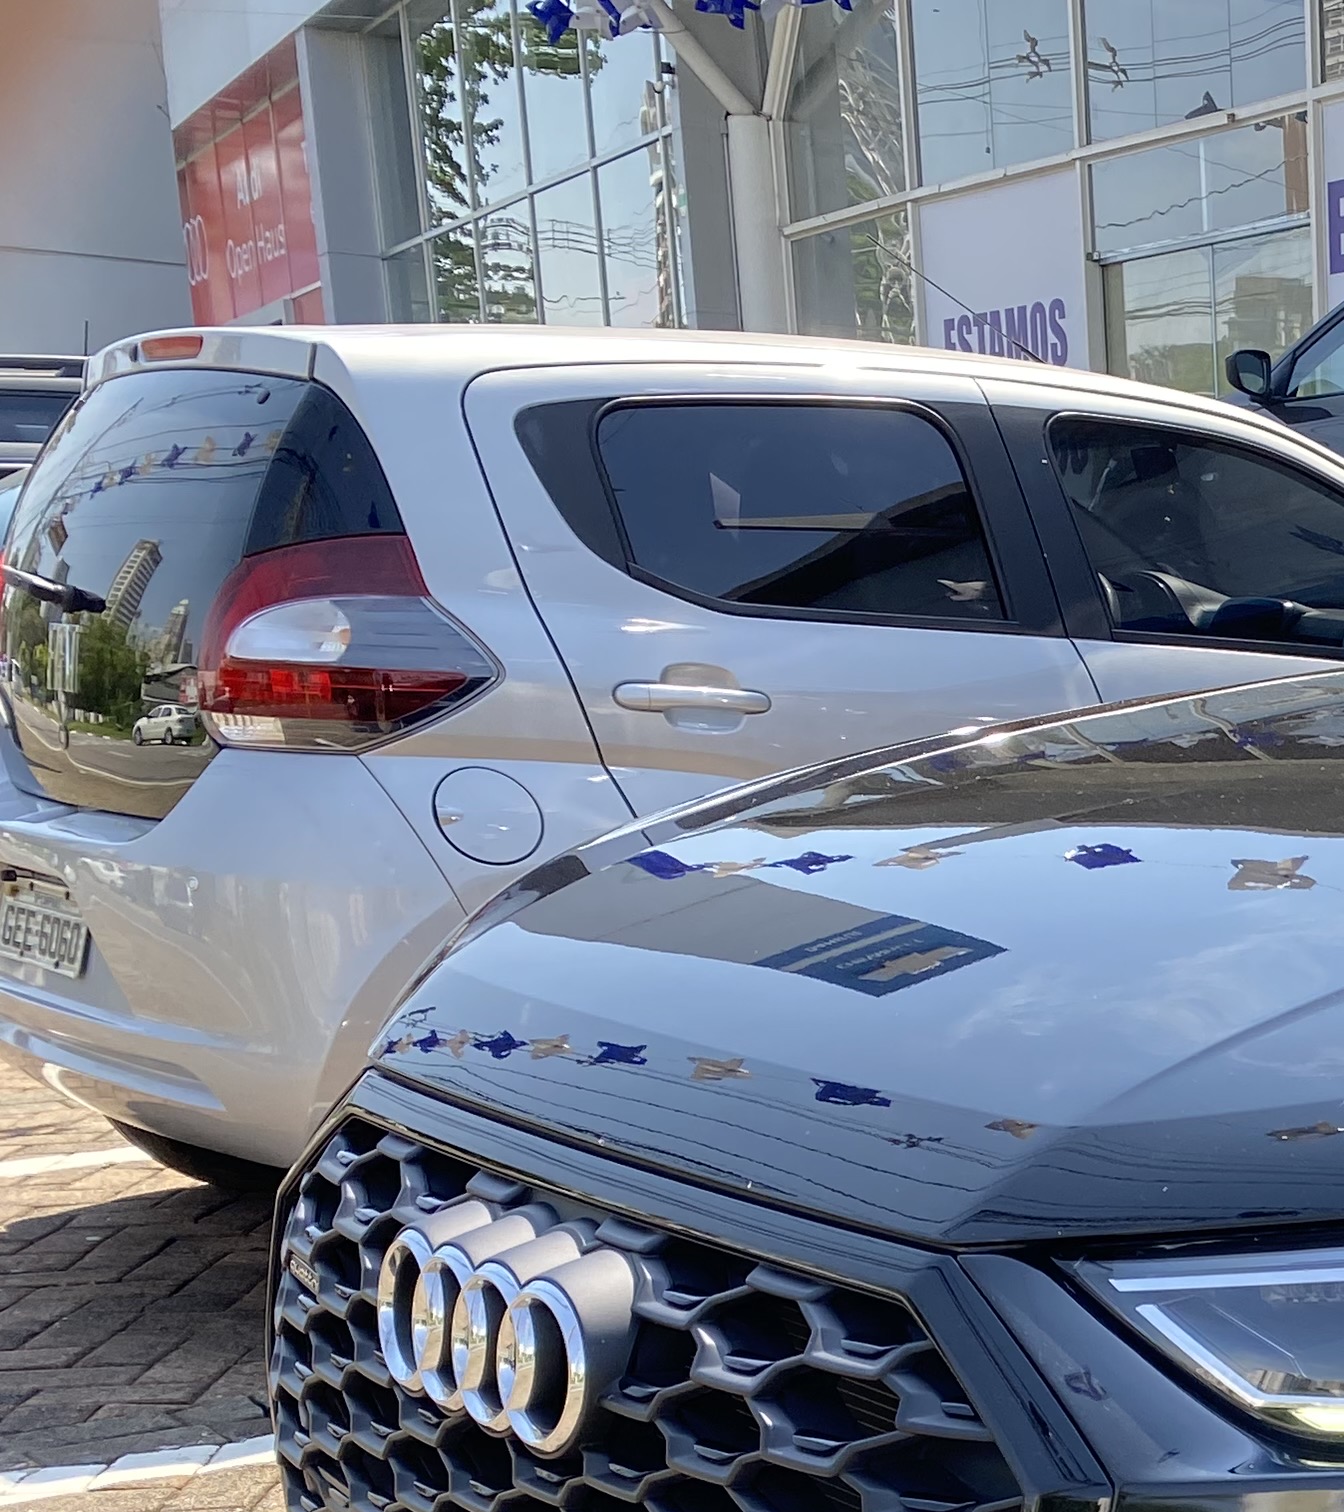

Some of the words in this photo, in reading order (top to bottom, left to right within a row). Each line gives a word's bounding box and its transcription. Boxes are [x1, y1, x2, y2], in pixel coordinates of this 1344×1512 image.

[226, 238, 258, 285] Open
[255, 223, 287, 264] Haus
[943, 298, 1068, 366] ESTAMOS
[2, 904, 82, 965] GEE-6060
